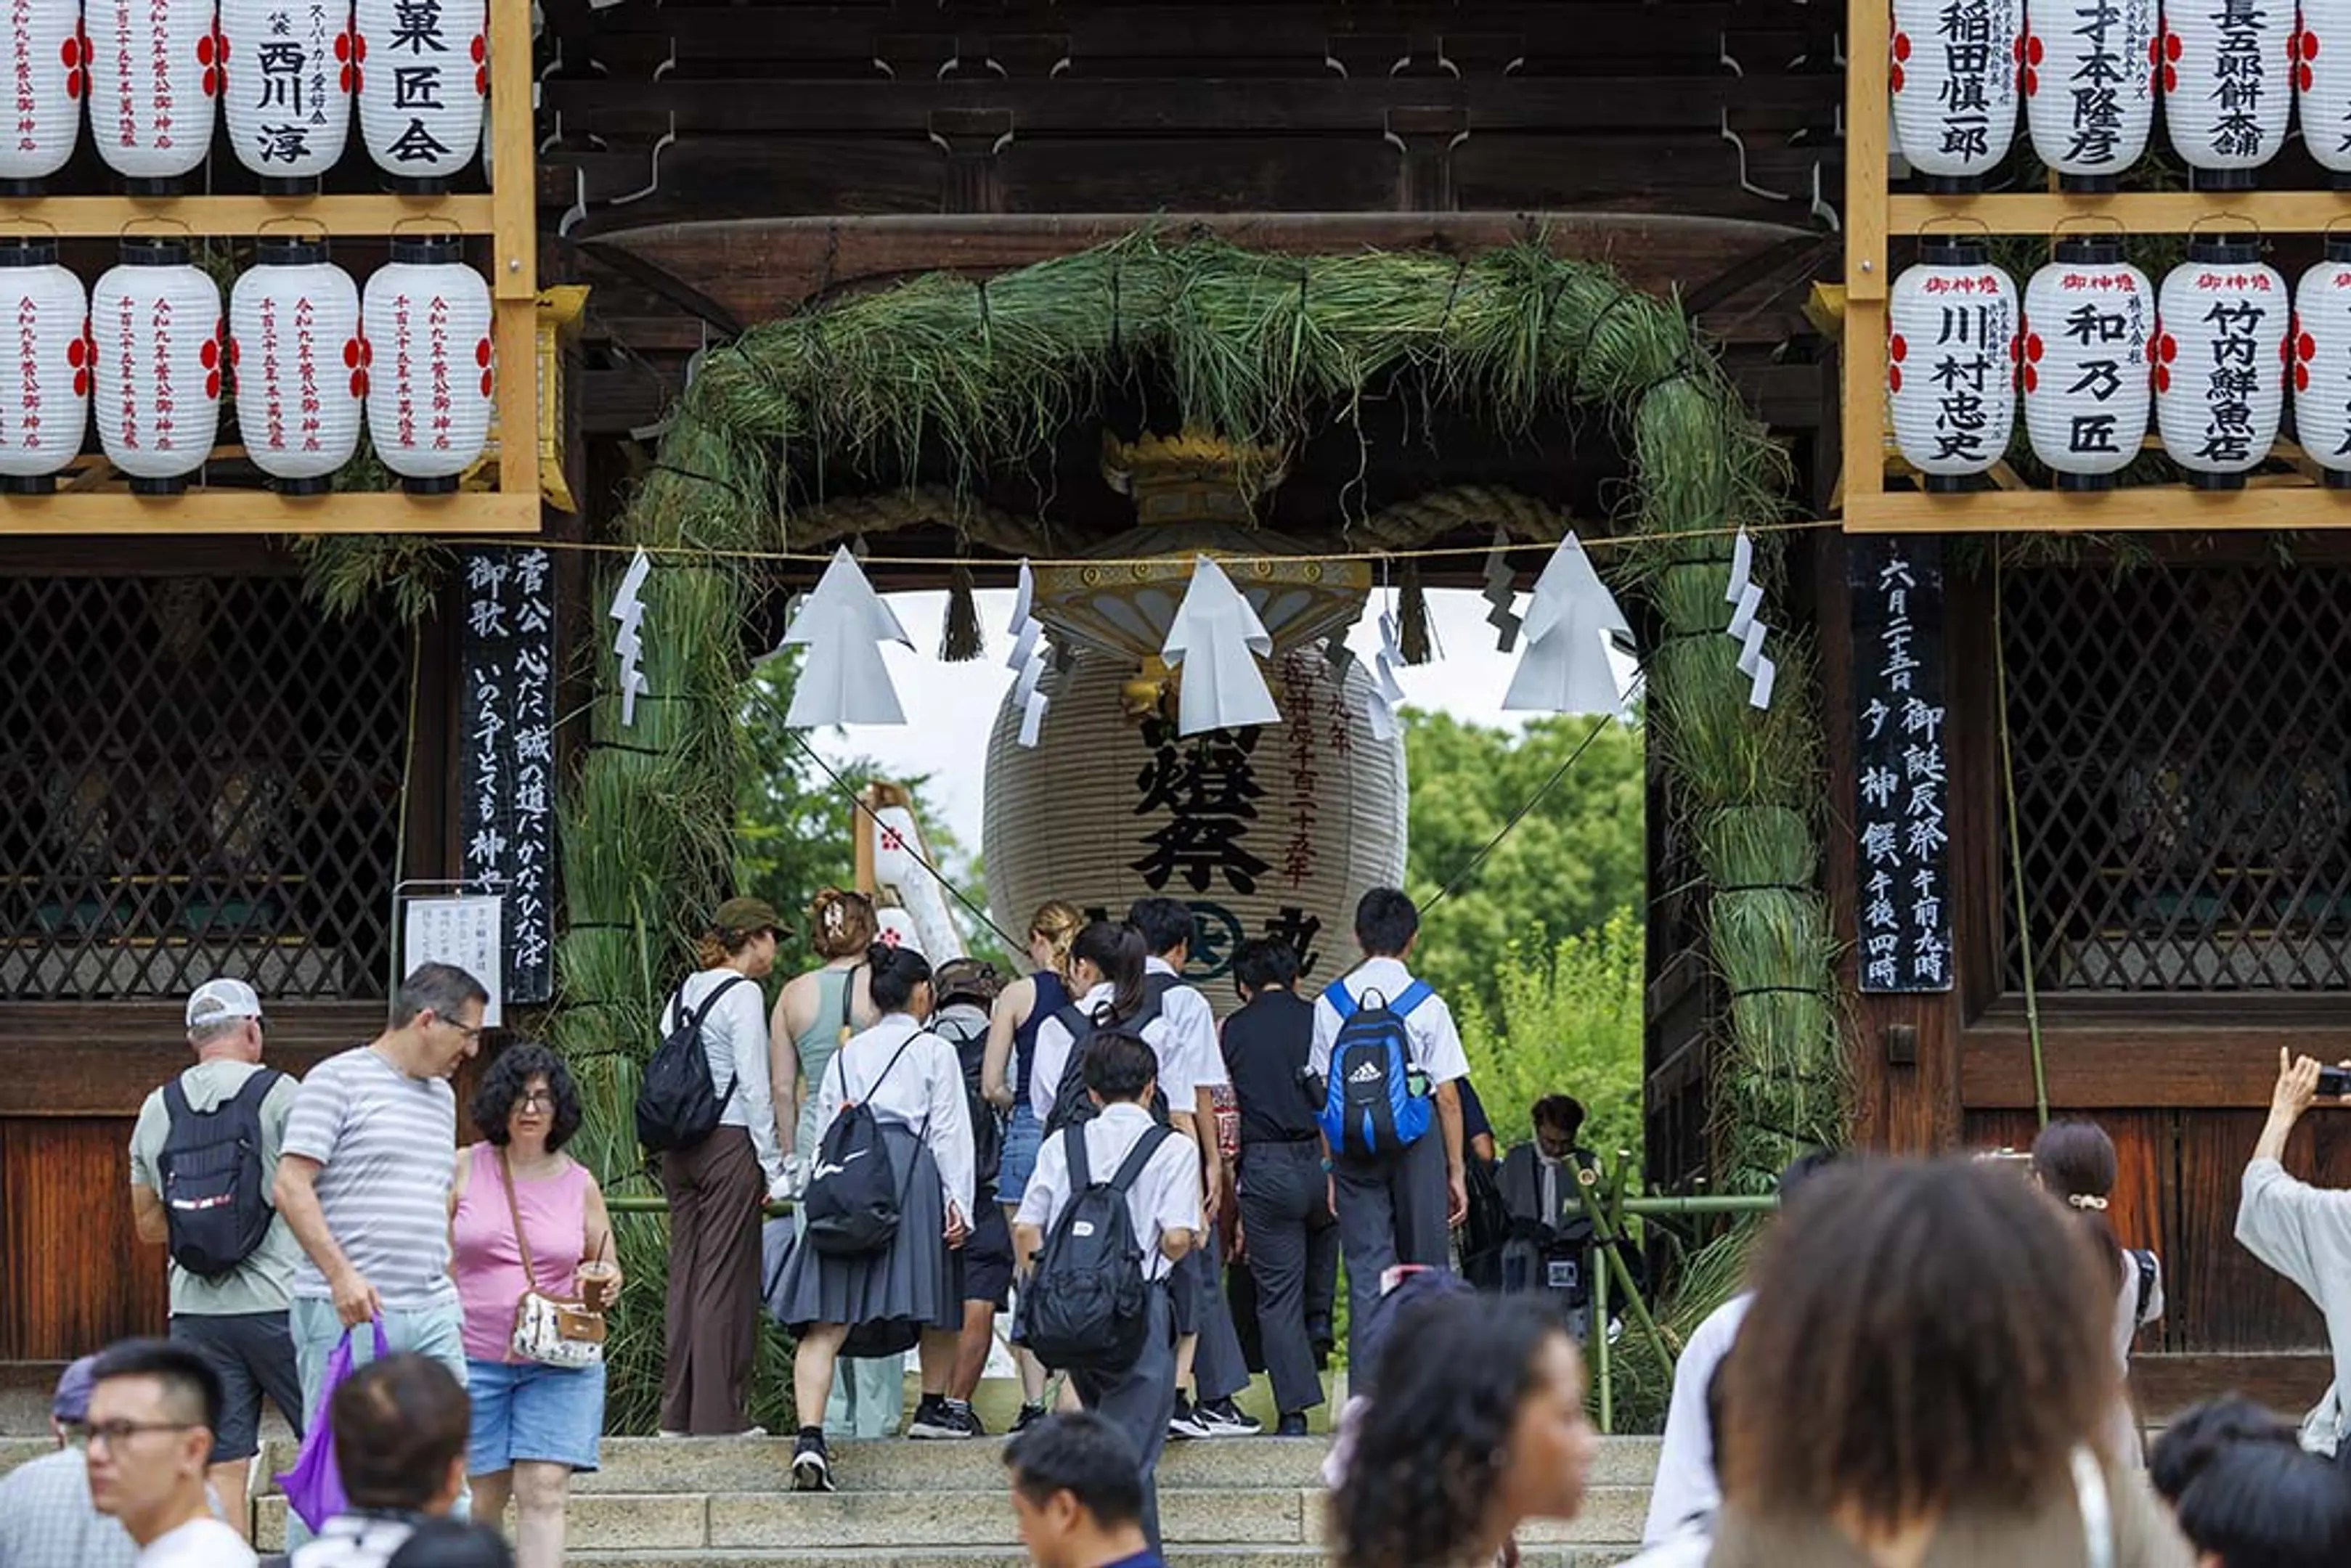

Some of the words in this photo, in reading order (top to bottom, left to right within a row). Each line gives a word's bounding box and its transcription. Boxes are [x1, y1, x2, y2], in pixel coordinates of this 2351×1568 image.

[256, 41, 311, 163] 西川淳
[386, 0, 453, 163] 菓匠会
[1937, 0, 1991, 164] 稲田慎一郎
[1929, 304, 1992, 461] 川村忠史
[2065, 303, 2128, 454] 和乃匠
[2126, 294, 2146, 365] 株式会社
[2193, 299, 2267, 463] 竹内鮮魚店
